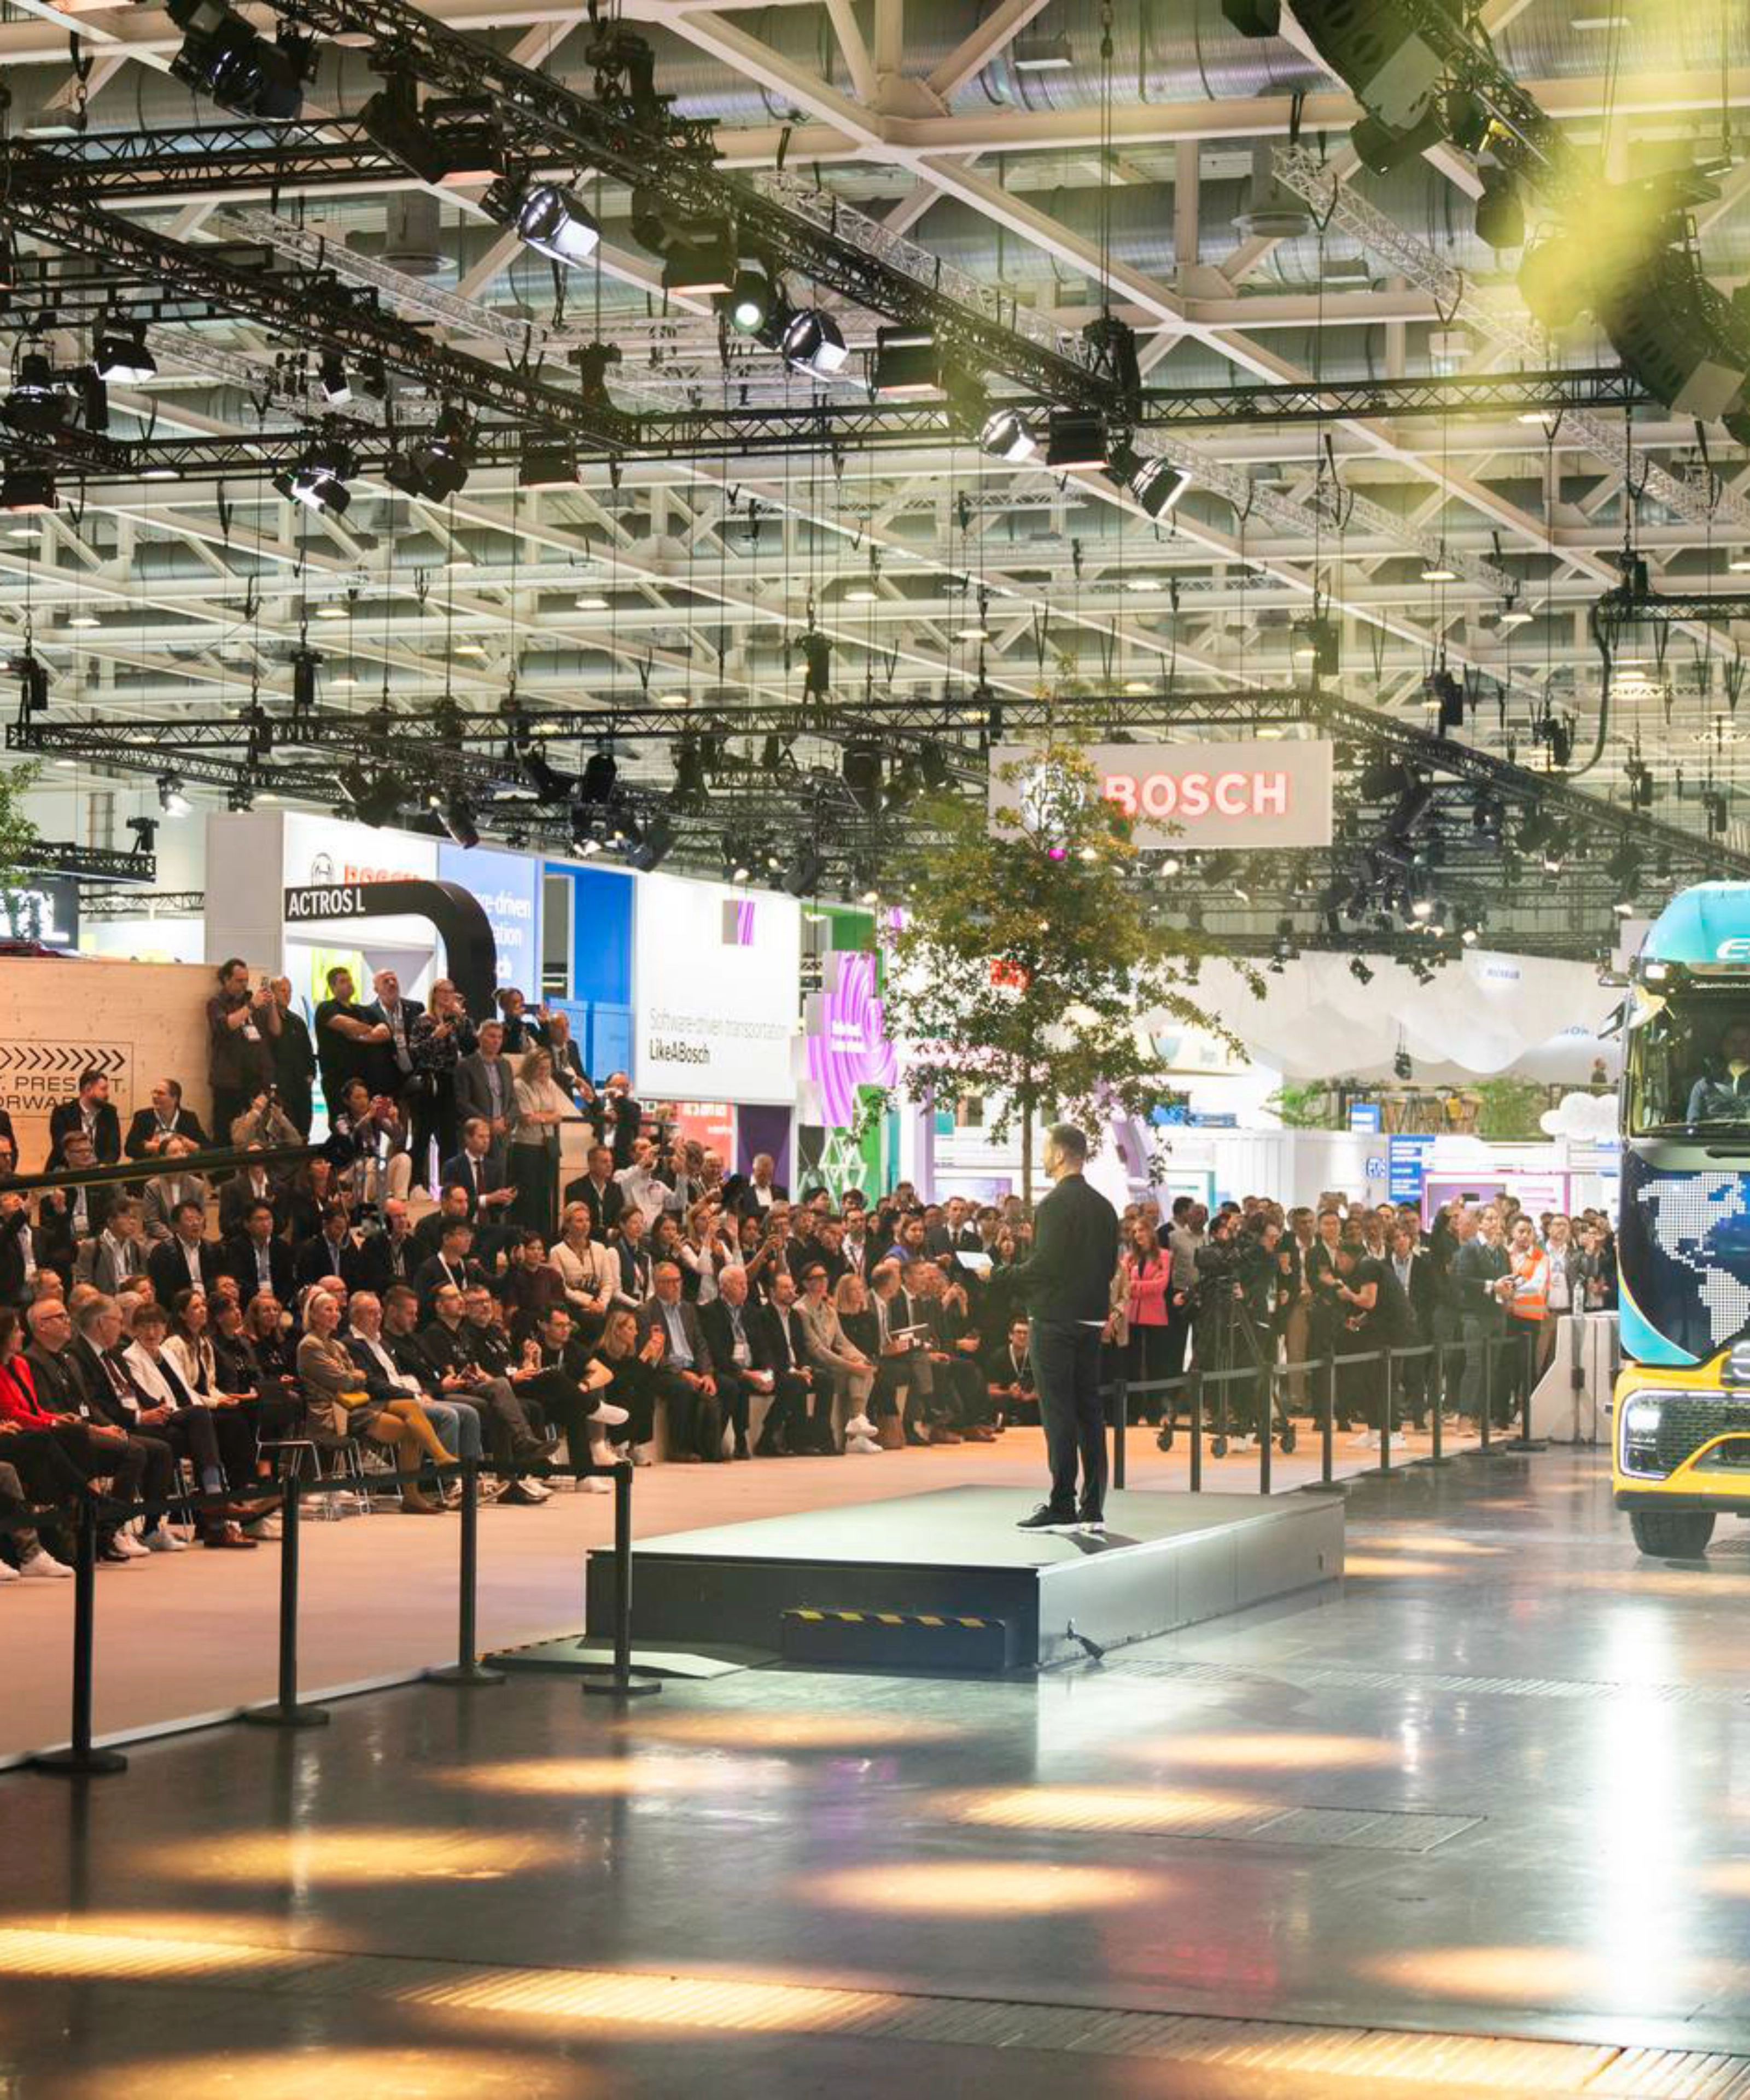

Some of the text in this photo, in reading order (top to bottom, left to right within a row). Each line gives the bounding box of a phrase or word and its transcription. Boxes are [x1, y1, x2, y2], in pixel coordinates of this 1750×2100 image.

[1105, 773, 1287, 816] BOSCH
[288, 888, 365, 917] ACTROS L
[650, 1038, 710, 1064] LikeABosch
[15, 1076, 126, 1093] PREST.
